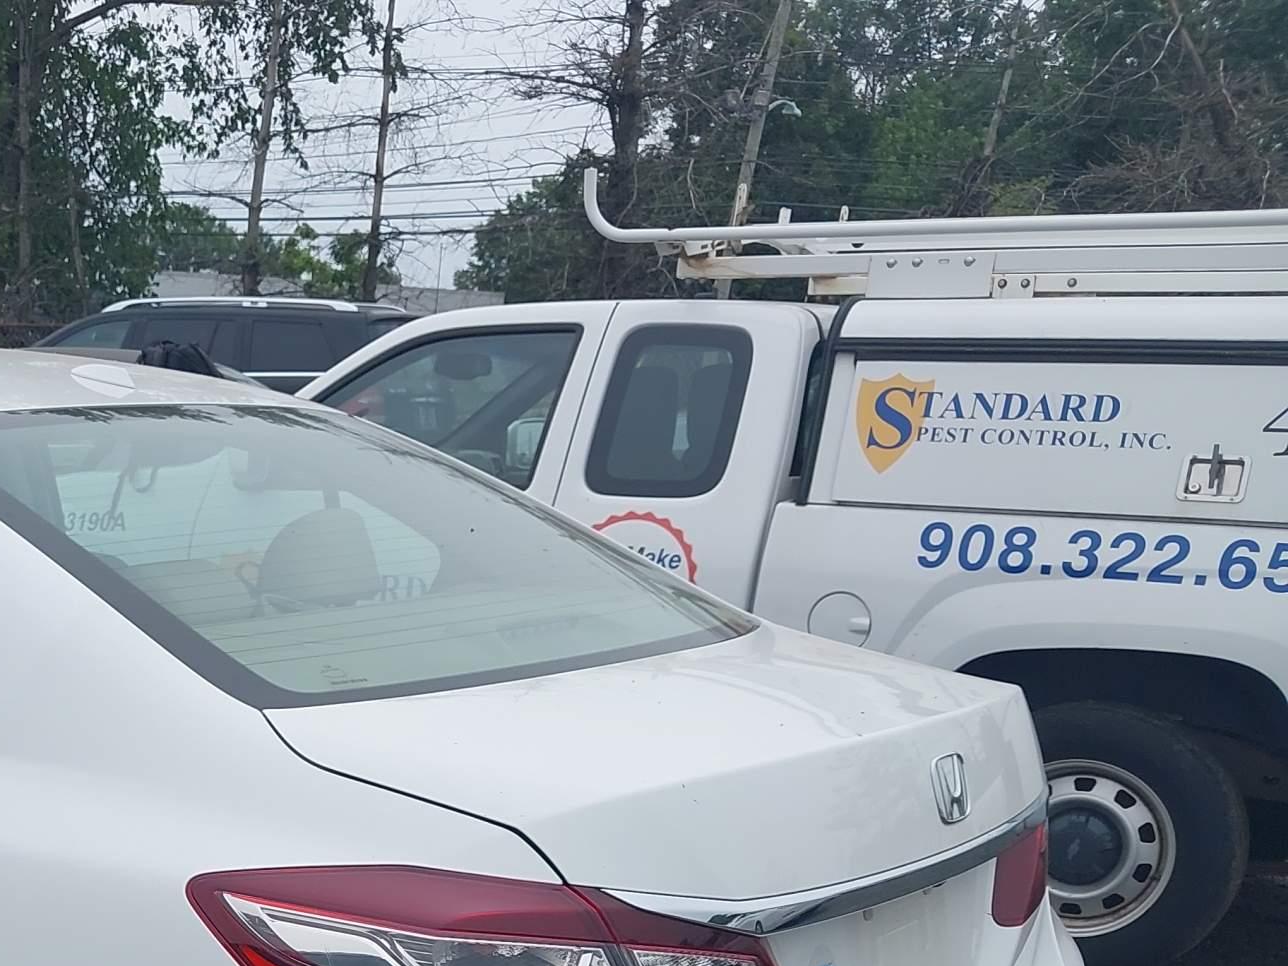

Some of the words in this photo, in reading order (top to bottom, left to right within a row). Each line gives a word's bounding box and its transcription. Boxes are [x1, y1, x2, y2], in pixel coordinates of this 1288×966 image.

[866, 386, 1121, 449] STANDARD
[915, 426, 974, 444] PEST
[980, 428, 1110, 451] CONTROL,
[1119, 431, 1172, 450] INC.
